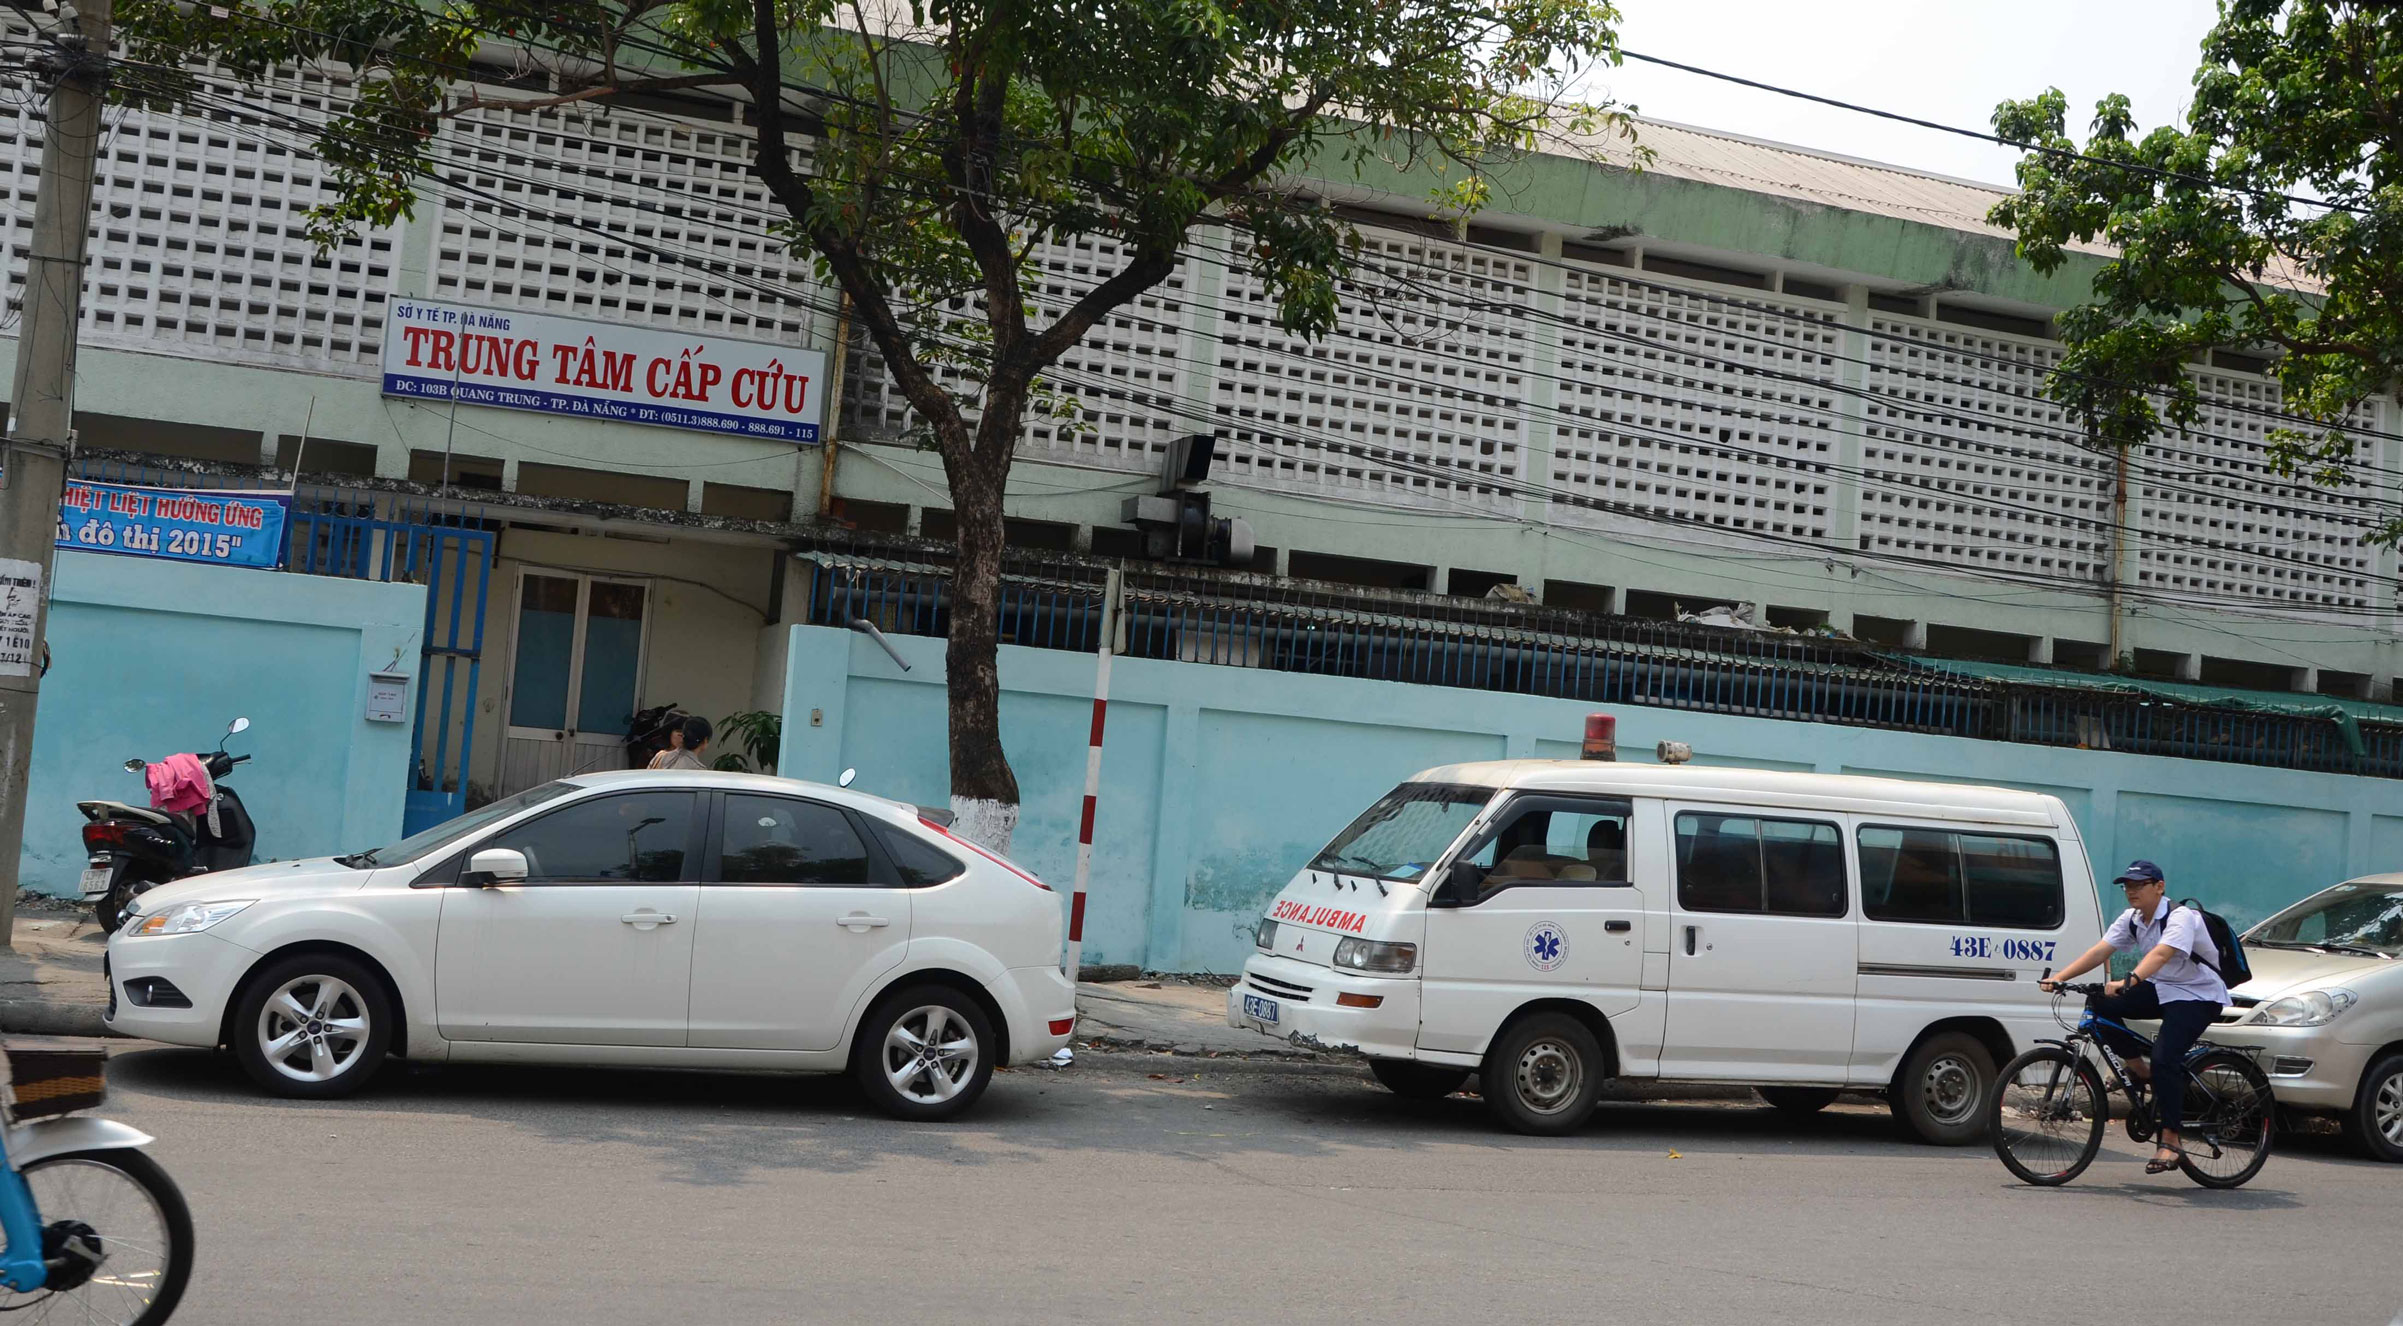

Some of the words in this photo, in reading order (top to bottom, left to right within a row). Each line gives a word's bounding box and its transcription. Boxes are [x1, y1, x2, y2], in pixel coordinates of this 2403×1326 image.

[397, 302, 413, 319] SỞ
[416, 308, 423, 319] Y
[427, 307, 441, 322] TẾ
[443, 311, 457, 324] TP.
[403, 326, 540, 382] TRUNG
[552, 336, 637, 393] TÂM
[646, 345, 722, 402] CẤP
[731, 358, 810, 414] CỨU
[396, 380, 417, 392] ĐC:
[420, 383, 447, 396] 103B
[451, 386, 494, 401] QUANG
[498, 392, 540, 407] TRUNG
[550, 398, 569, 411] TP.
[573, 398, 589, 413] ĐÀ
[639, 408, 659, 420] ĐT:
[748, 423, 786, 436] 888.691
[796, 428, 813, 440] 115
[63, 486, 104, 513] HIỆT
[108, 491, 151, 519] LIỆT
[224, 500, 264, 530] ỨNG
[79, 519, 115, 547] đô
[122, 524, 160, 553] thị
[1949, 935, 1992, 959] 43E
[2003, 938, 2057, 961] 0887
